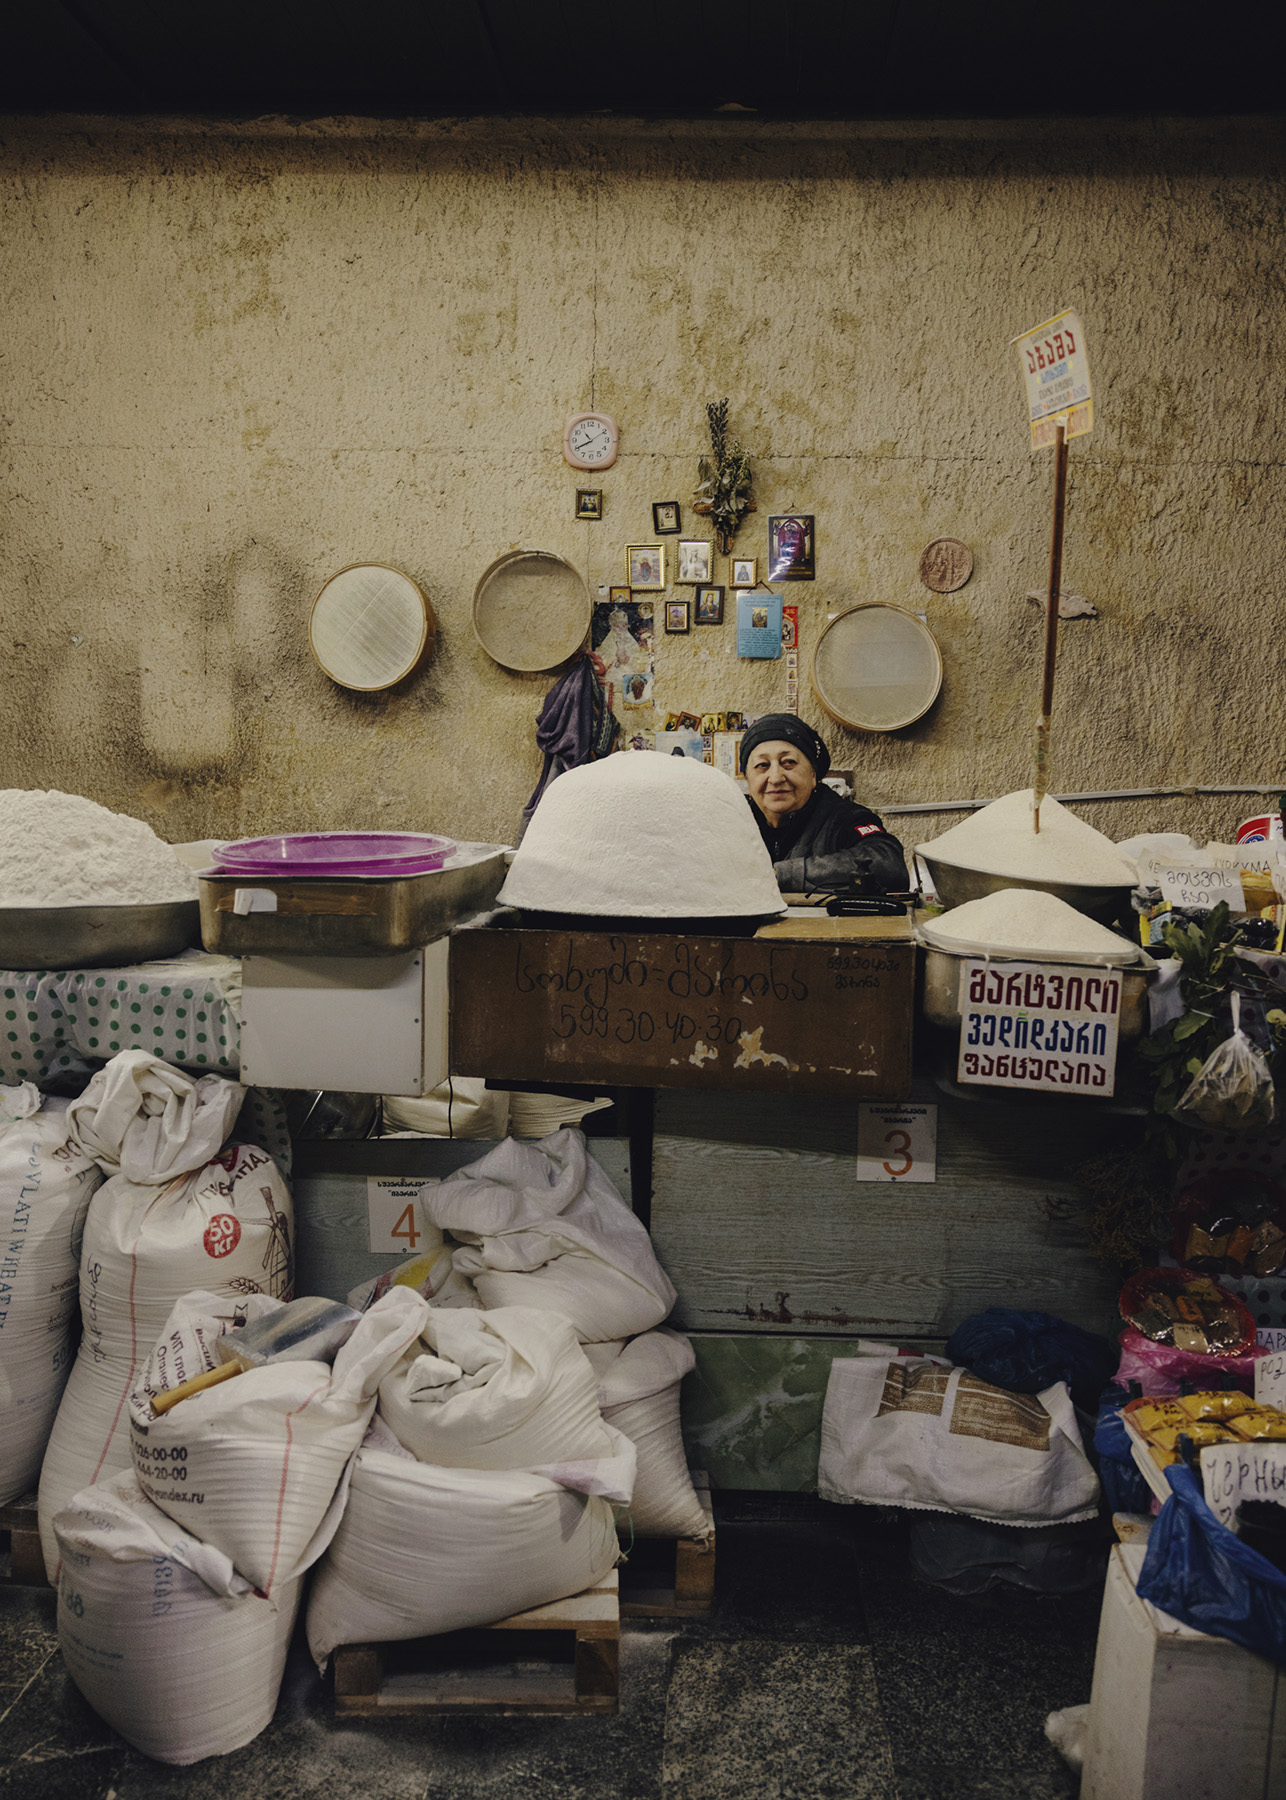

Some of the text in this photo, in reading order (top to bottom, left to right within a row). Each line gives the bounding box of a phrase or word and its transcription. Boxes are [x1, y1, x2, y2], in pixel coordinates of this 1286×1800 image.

[1025, 329, 1076, 375] აბაშა
[586, 420, 595, 428] 12
[596, 450, 602, 458] 5
[969, 968, 1119, 1014] მარტვილი
[967, 1013, 1107, 1056] ვედიდკარი
[964, 1052, 1107, 1087] ფანცულაია
[882, 1129, 913, 1177] 3
[210, 1216, 234, 1242] 50
[391, 1203, 421, 1248] 4
